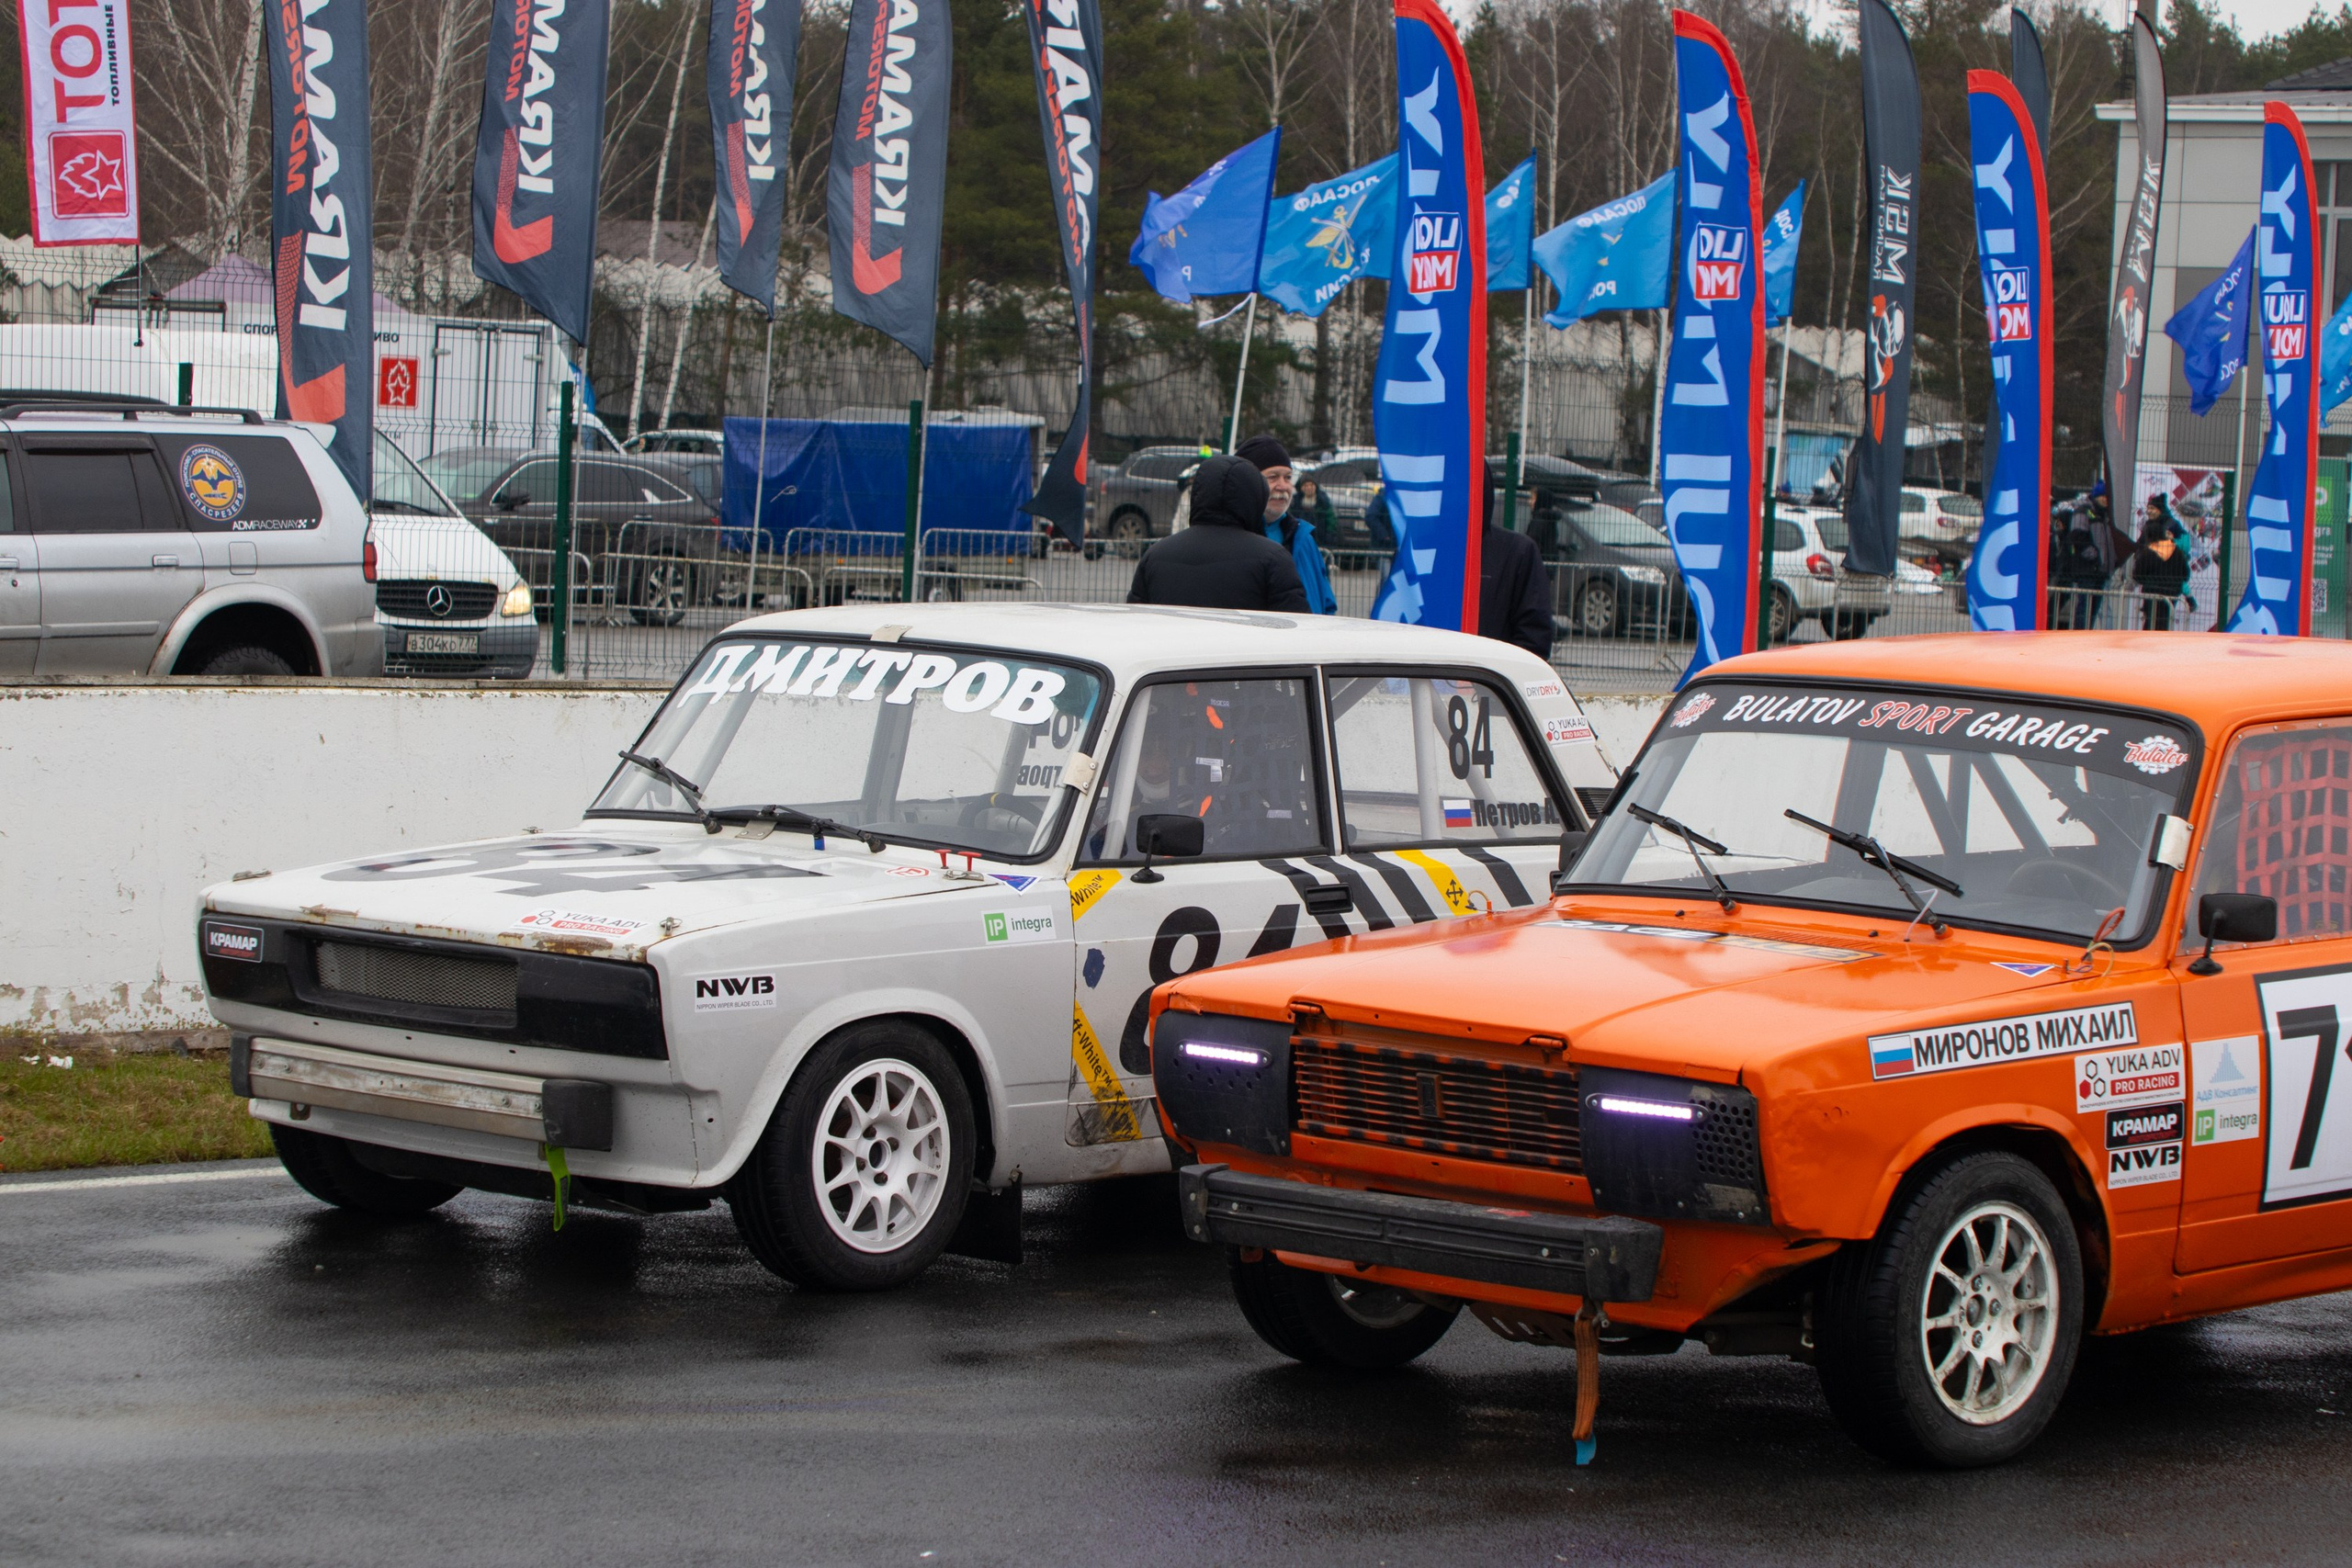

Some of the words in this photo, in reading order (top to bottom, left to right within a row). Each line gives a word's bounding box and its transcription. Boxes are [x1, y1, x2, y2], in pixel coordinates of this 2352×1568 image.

[105, 5, 120, 106] ТОПЛИВНЫЕ
[189, 492, 243, 519] СПАСРЕЗЕРВ
[676, 644, 1066, 725] ДМИТРОВ
[1448, 694, 1495, 780] 84
[1723, 694, 1866, 726] BULATOV
[1858, 700, 1973, 736] SPORT
[1965, 711, 2109, 753] GARAGE
[2123, 741, 2189, 767] Bulatov
[1474, 799, 1542, 829] Петров
[563, 912, 606, 925] YUKA
[607, 919, 649, 929] ADV
[582, 924, 626, 935] RACING
[1011, 916, 1053, 931] integra
[209, 931, 258, 951] КРАМАР
[696, 976, 775, 998] NWB
[1914, 1023, 2030, 1068] МИРОНОВ
[2035, 1009, 2134, 1051] МИХАИЛ
[2106, 1054, 2149, 1075] YUKA
[2152, 1048, 2180, 1069] ADV
[2115, 1081, 2135, 1094] PRO
[2138, 1075, 2176, 1092] RACING
[2277, 1004, 2352, 1170] 7
[2112, 1112, 2178, 1137] КРАМАР
[2220, 1112, 2257, 1131] integra
[2110, 1145, 2180, 1173] NWB
